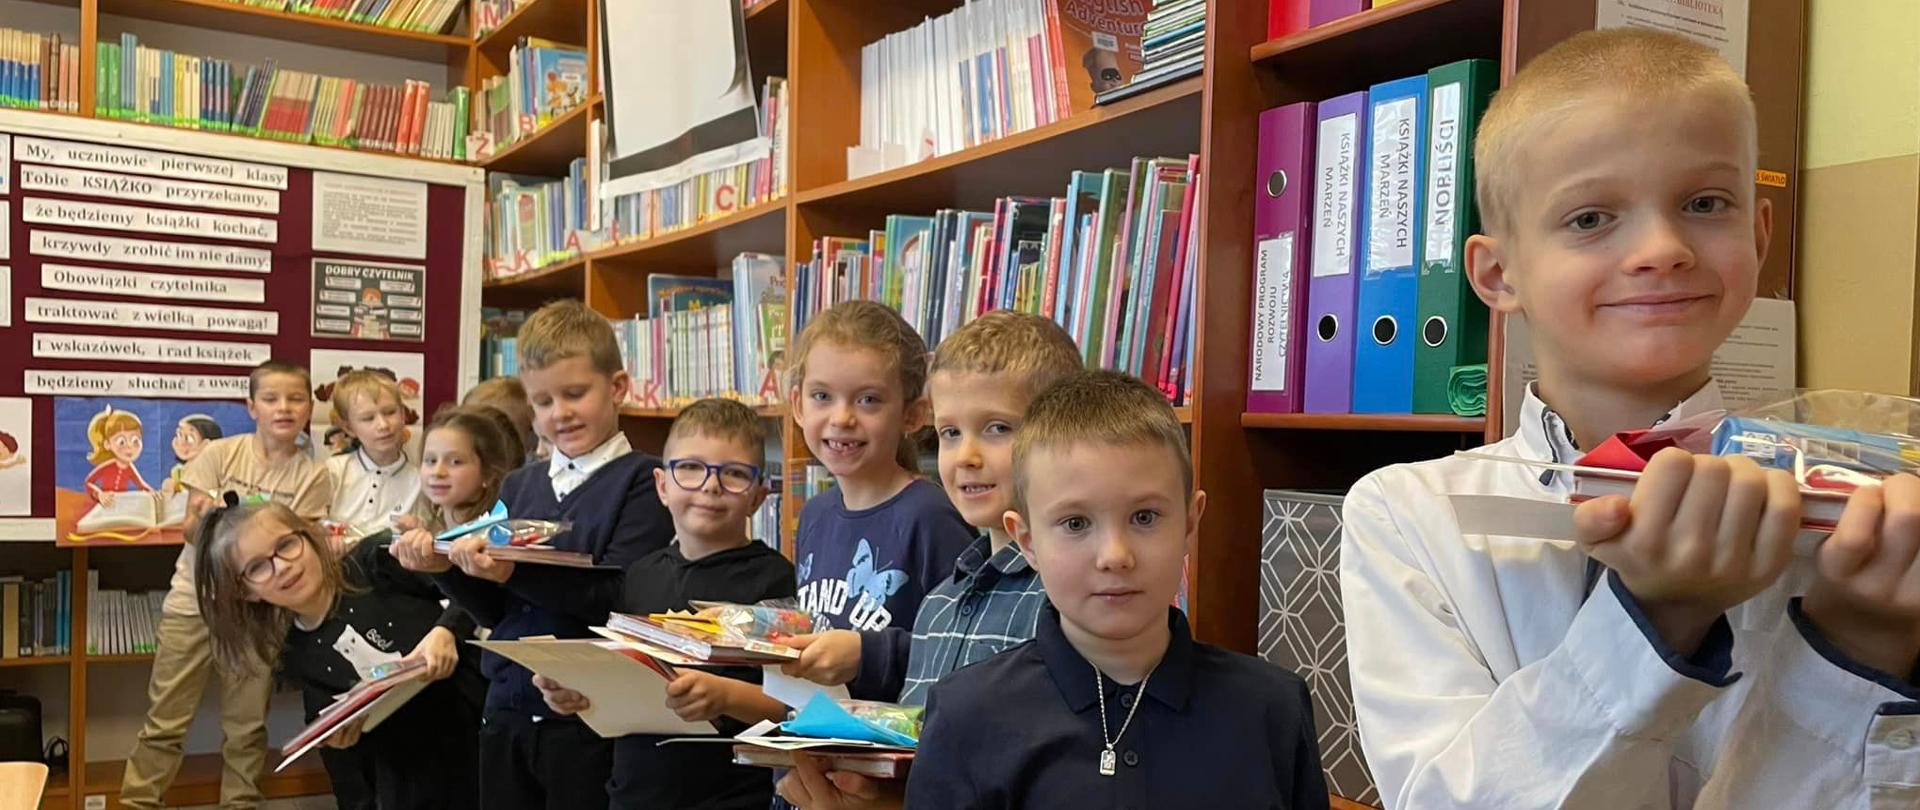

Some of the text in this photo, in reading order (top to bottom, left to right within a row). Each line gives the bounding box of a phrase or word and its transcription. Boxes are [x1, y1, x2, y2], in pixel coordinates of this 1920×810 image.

[23, 170, 69, 186] Tobie
[83, 175, 152, 194] KSIĄŻKO
[68, 149, 147, 167] uczniowie
[160, 158, 234, 178] pierwszej
[246, 167, 285, 185] klasy
[1396, 117, 1411, 248] KSIĄŻKI NASZYCH
[1434, 118, 1455, 226] NOBLIŚCI
[1323, 166, 1334, 228] MARZEŃ
[1336, 132, 1351, 257] KSIĄŻKI NASZYCH
[1379, 153, 1391, 219] MARZEŃ
[35, 204, 53, 217] że
[58, 206, 135, 226] będziemy
[146, 212, 200, 229] książki
[42, 236, 111, 256] krzywdy
[123, 243, 173, 257] zrobić
[176, 246, 195, 260] im
[199, 249, 222, 261] nie
[54, 270, 227, 293] Obowiązki czytelnika
[325, 265, 414, 281] DOBRY CZYTELNIK
[38, 304, 118, 321] traktować
[144, 310, 194, 326] wielką
[207, 316, 268, 330] powagą!
[1255, 249, 1268, 382] NARODOWY PROGRAM
[1267, 285, 1278, 343] ROZWOJU
[51, 339, 145, 355] wskazówek,
[167, 346, 192, 358] rad
[196, 346, 252, 362] książek
[37, 375, 113, 391] będziemy
[210, 378, 248, 390] uwag
[797, 578, 849, 616] TAND
